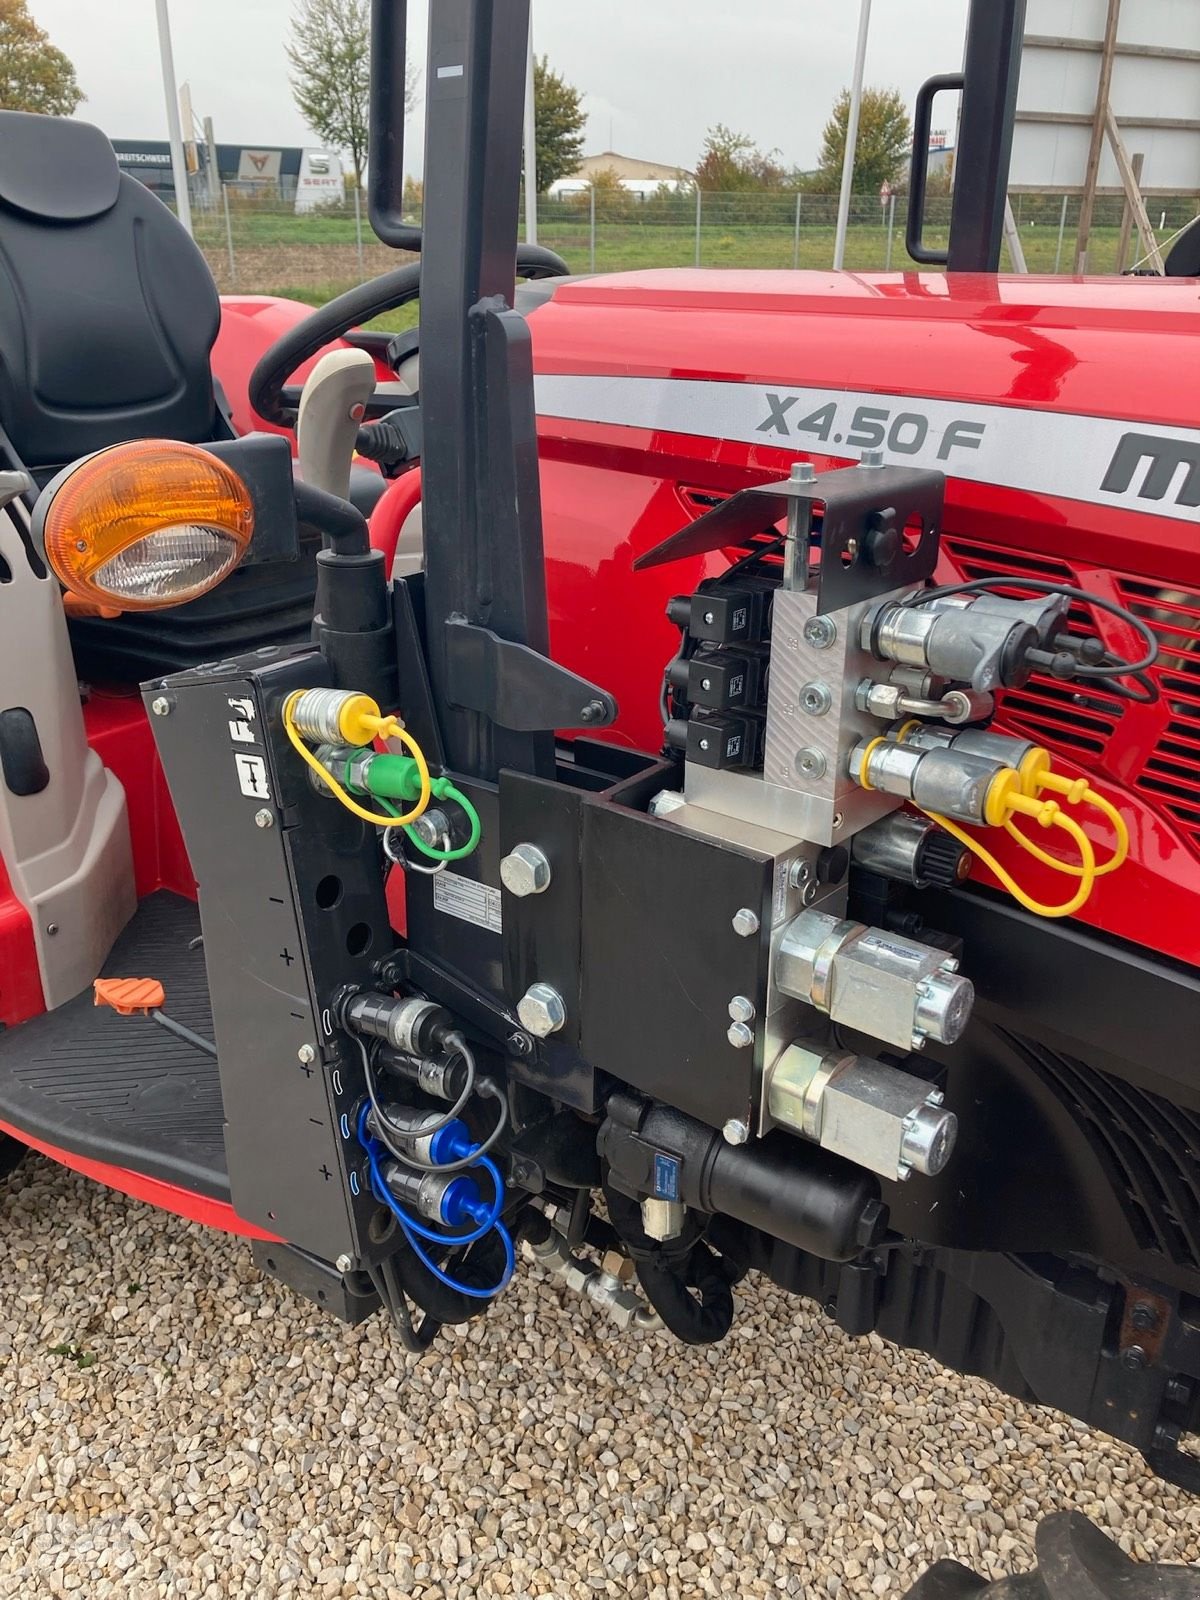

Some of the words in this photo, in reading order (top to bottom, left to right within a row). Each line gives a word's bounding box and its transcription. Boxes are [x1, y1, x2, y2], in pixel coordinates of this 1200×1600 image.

[303, 178, 337, 186] SEAT
[755, 393, 929, 455] X4.50
[936, 420, 986, 460] F
